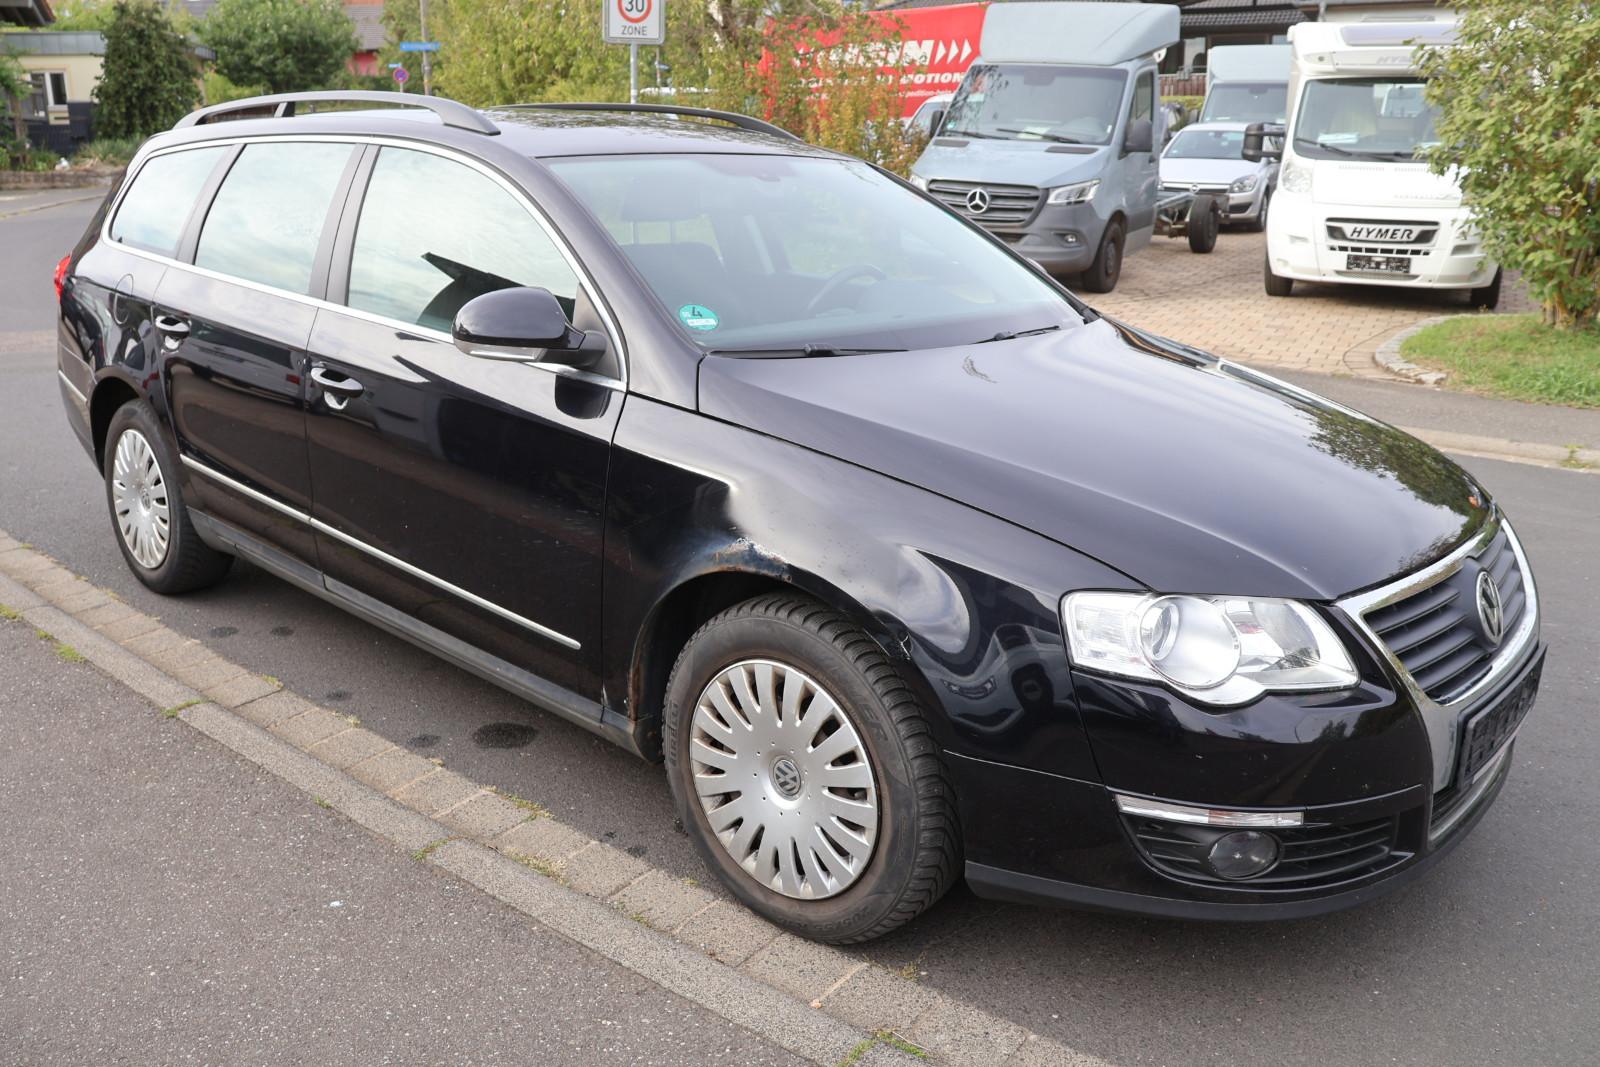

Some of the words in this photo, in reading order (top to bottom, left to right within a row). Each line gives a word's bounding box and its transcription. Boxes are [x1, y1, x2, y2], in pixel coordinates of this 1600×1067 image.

[625, 0, 644, 12] 30
[621, 25, 648, 35] ZONE
[1350, 226, 1413, 240] HYMER
[692, 306, 702, 317] 4
